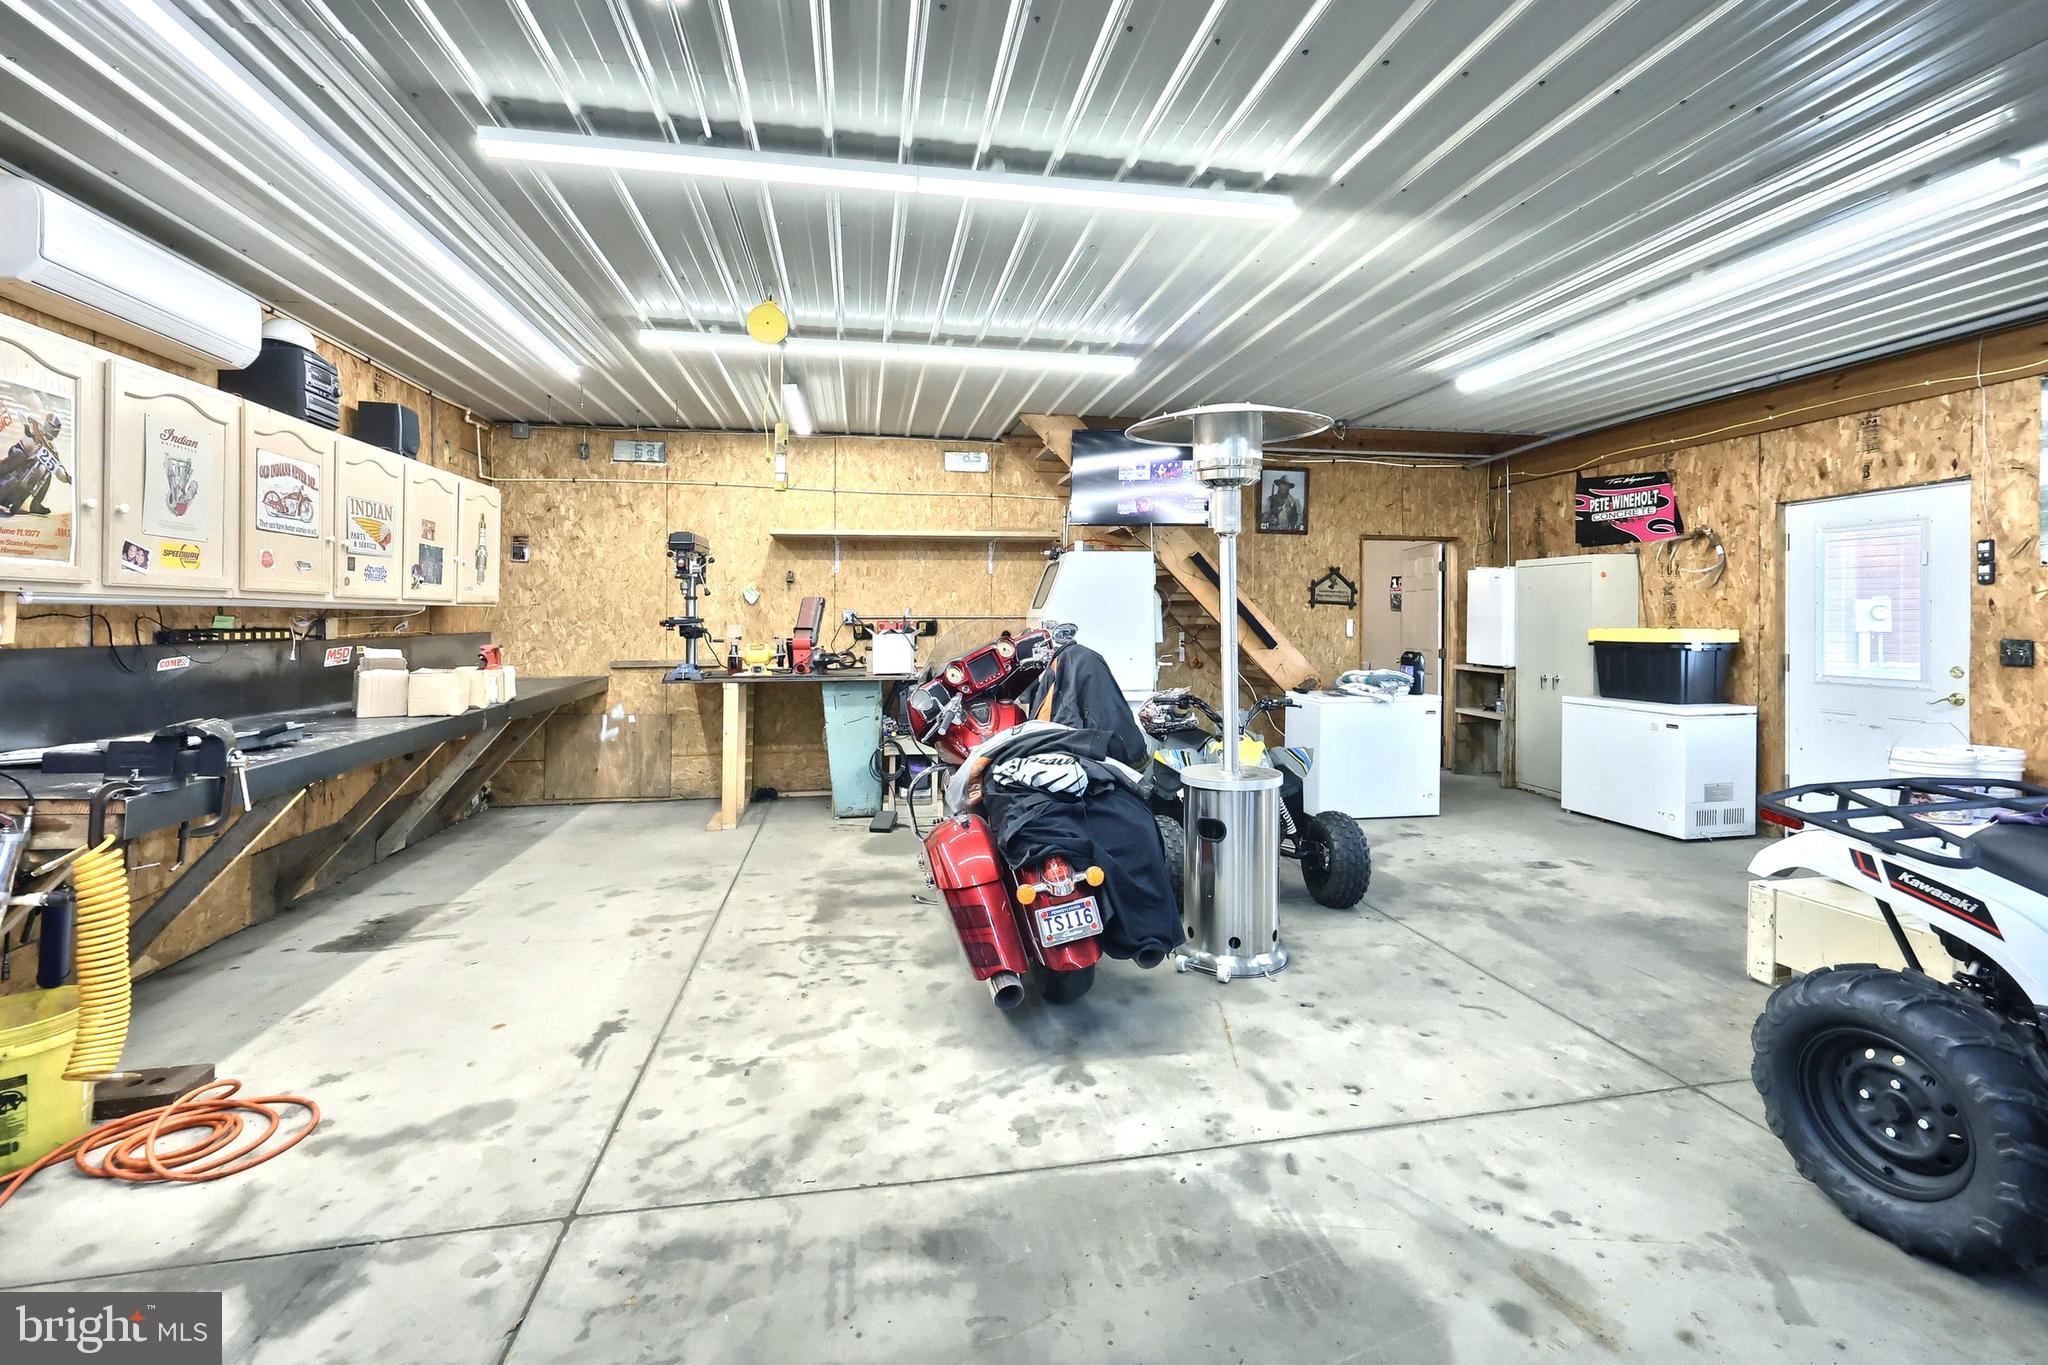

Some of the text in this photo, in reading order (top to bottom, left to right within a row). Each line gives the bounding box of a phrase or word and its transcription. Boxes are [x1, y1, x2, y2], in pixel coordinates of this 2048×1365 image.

[160, 428, 199, 449] Indian
[40, 448, 58, 471] 25
[259, 465, 270, 479] OLD
[270, 462, 291, 478] INDIANS
[291, 464, 307, 486] NEVER
[350, 498, 393, 521] INDIAN
[1589, 489, 1659, 513] PETE WINEHOLT
[1592, 507, 1654, 522] CONCRETE
[350, 531, 366, 541] PARTS
[358, 541, 377, 550] SERVICE
[162, 549, 200, 561] SPEEDWAY
[327, 648, 350, 660] MSD
[1898, 871, 1979, 913] Kawasaki
[1051, 904, 1081, 915] PENNSYLVANIA
[1043, 908, 1094, 934] TS116
